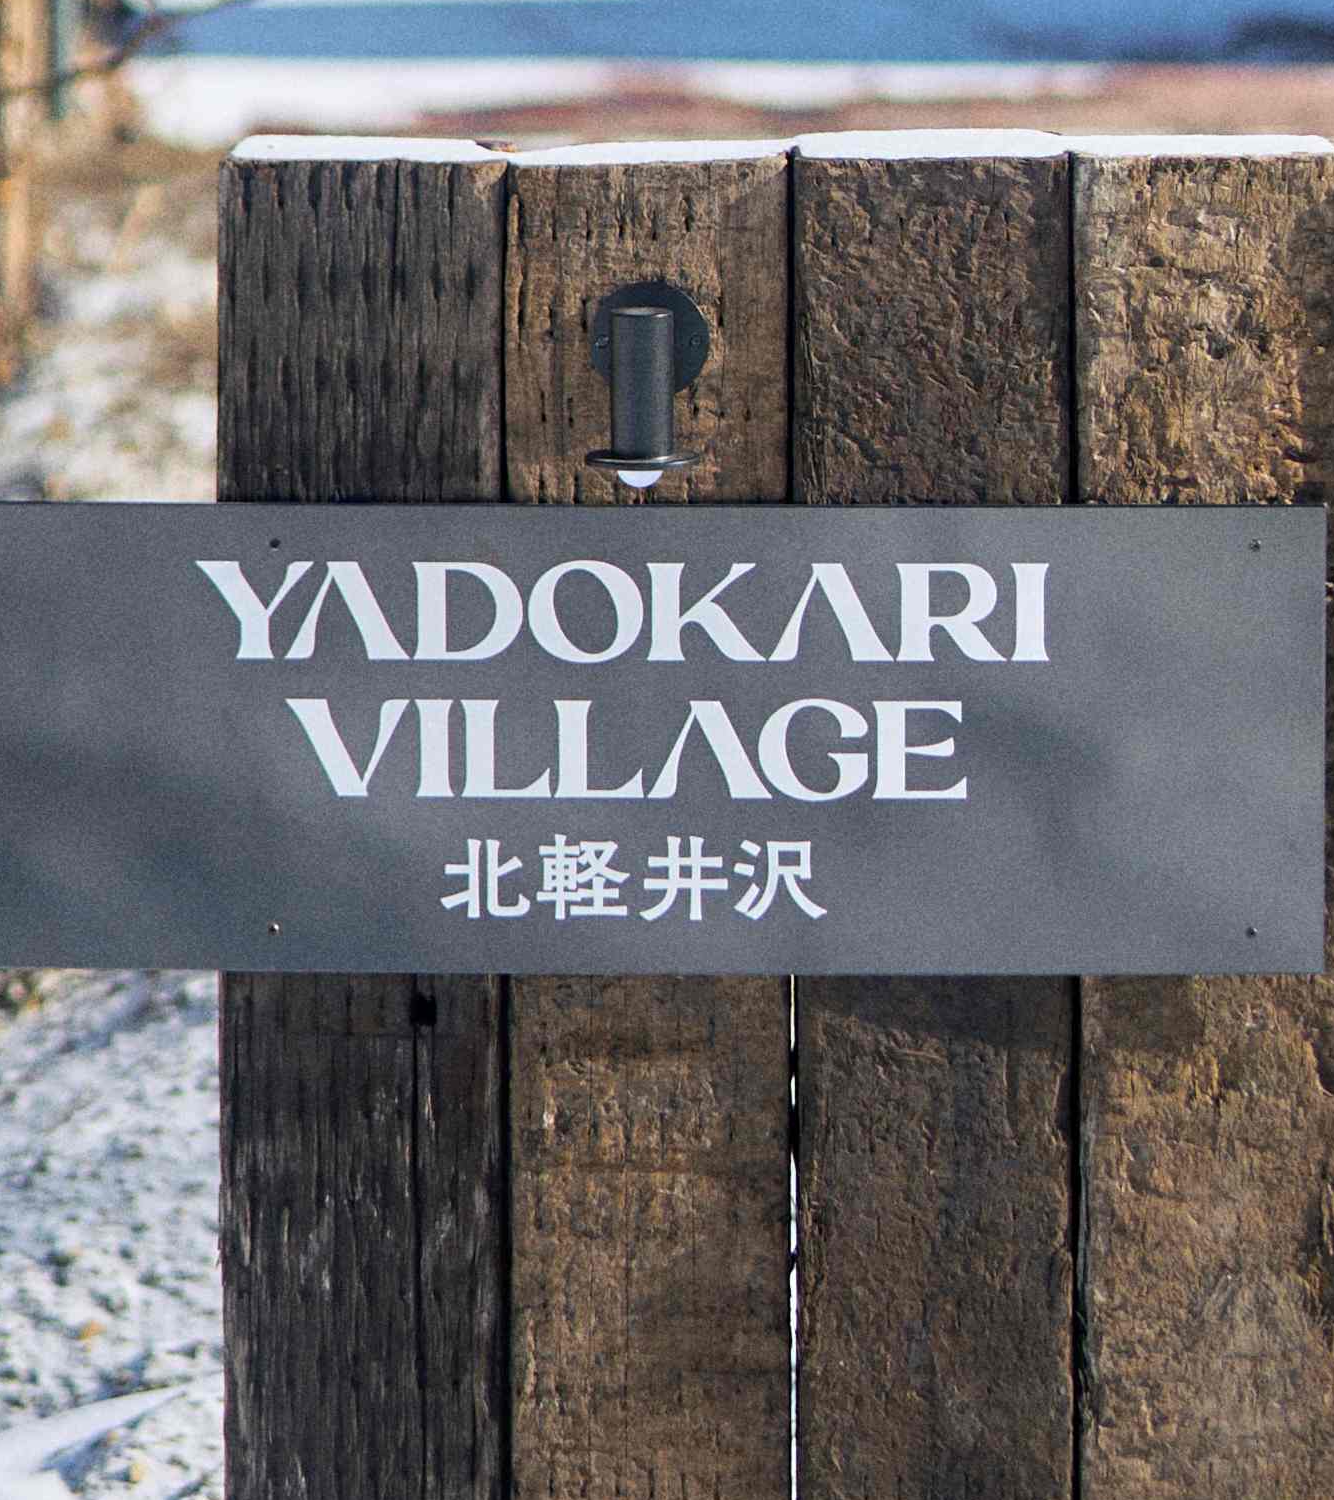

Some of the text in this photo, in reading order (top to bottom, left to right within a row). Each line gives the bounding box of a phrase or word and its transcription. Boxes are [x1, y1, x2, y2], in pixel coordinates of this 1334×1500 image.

[197, 560, 1050, 663] YADOKARI
[287, 699, 968, 801] VILLAGE
[441, 834, 827, 920] 北軽井沢
